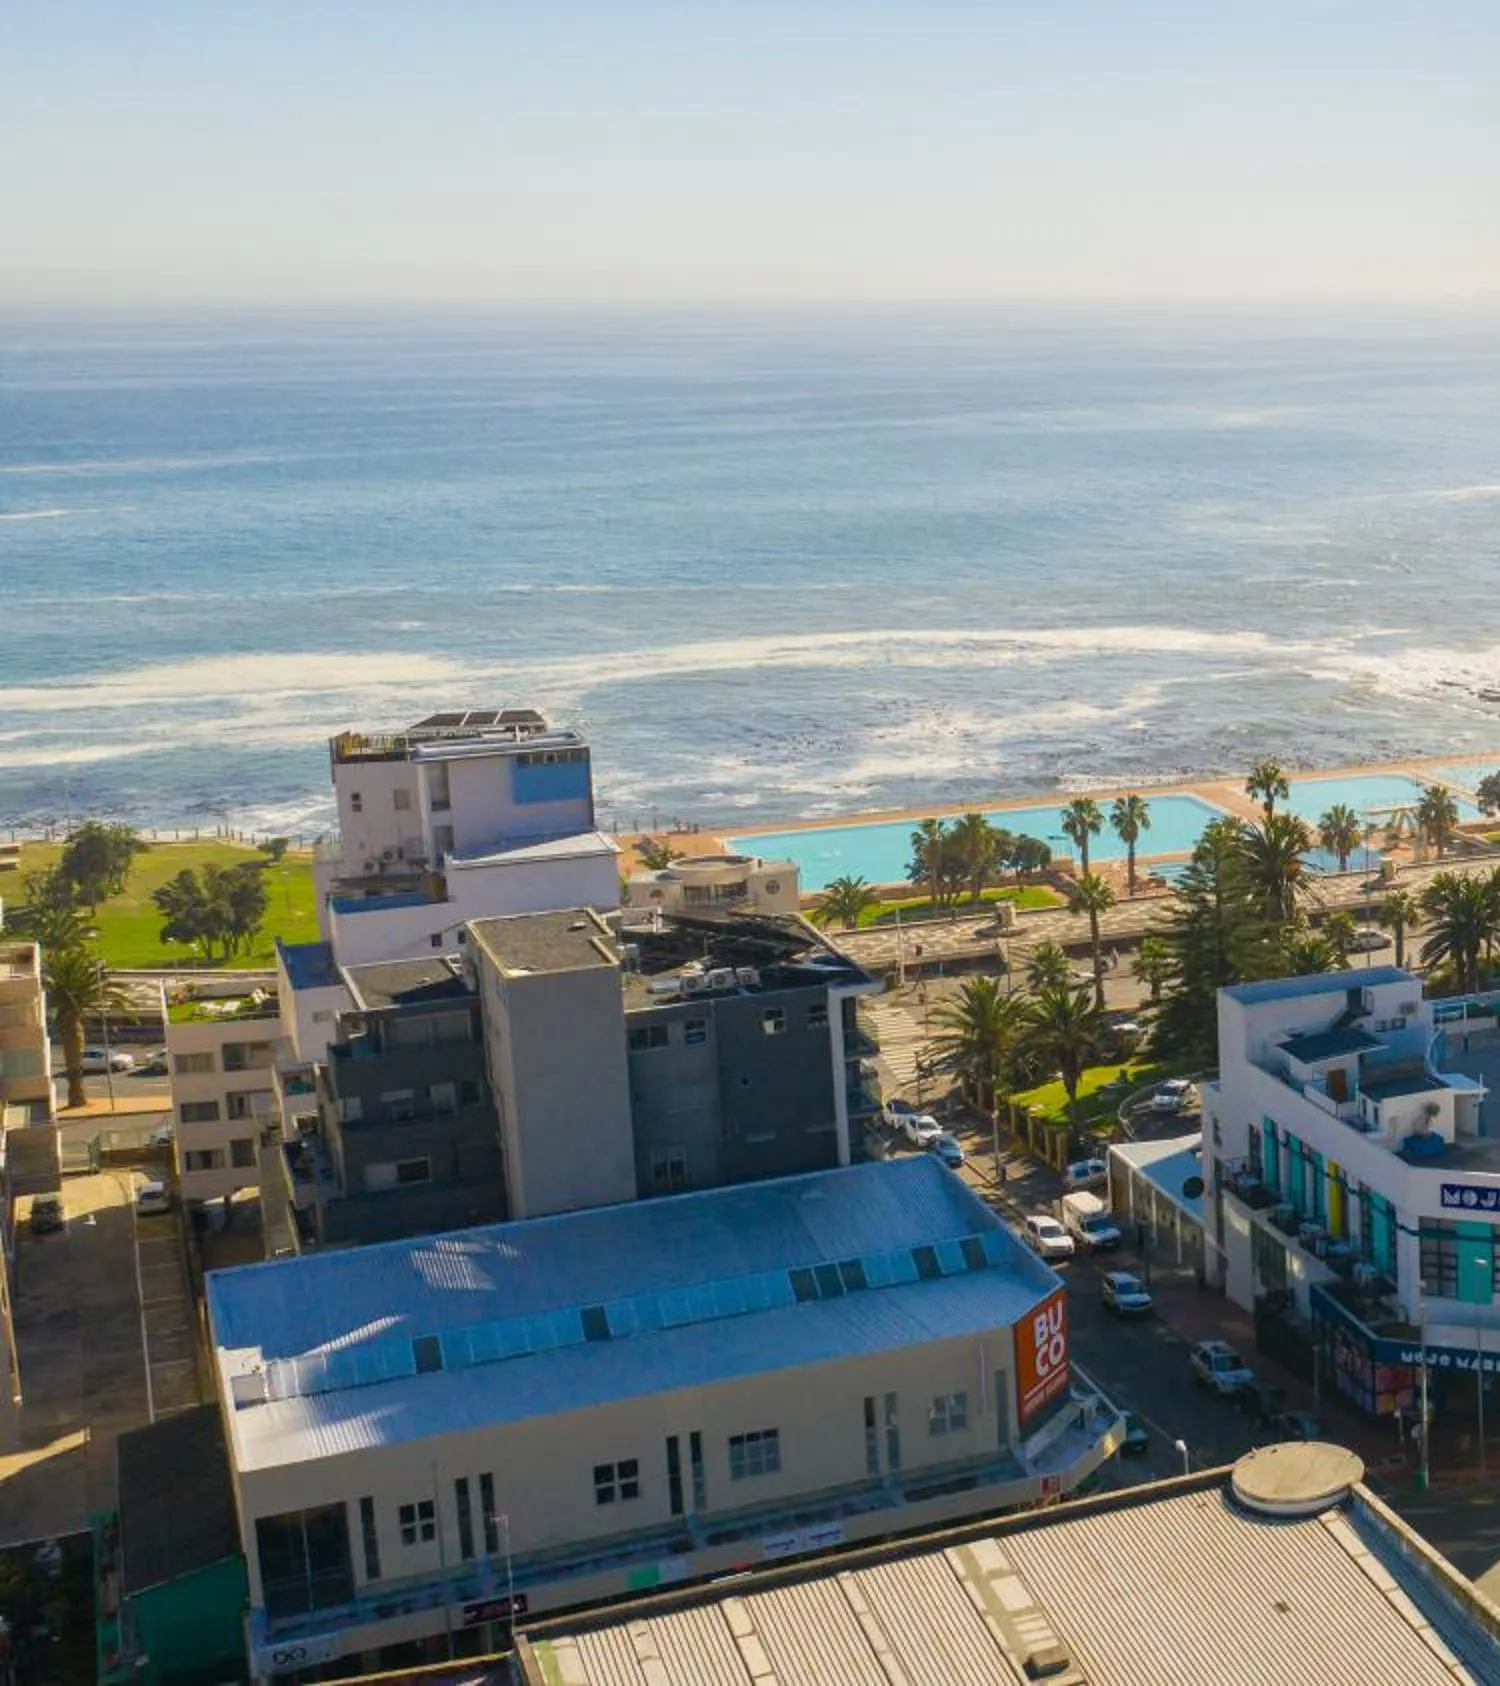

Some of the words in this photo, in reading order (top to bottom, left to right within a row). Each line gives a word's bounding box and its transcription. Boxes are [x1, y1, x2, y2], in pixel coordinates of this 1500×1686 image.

[1034, 1300, 1063, 1348] BU
[1036, 1333, 1065, 1377] CO
[1400, 1350, 1451, 1367] MOJO
